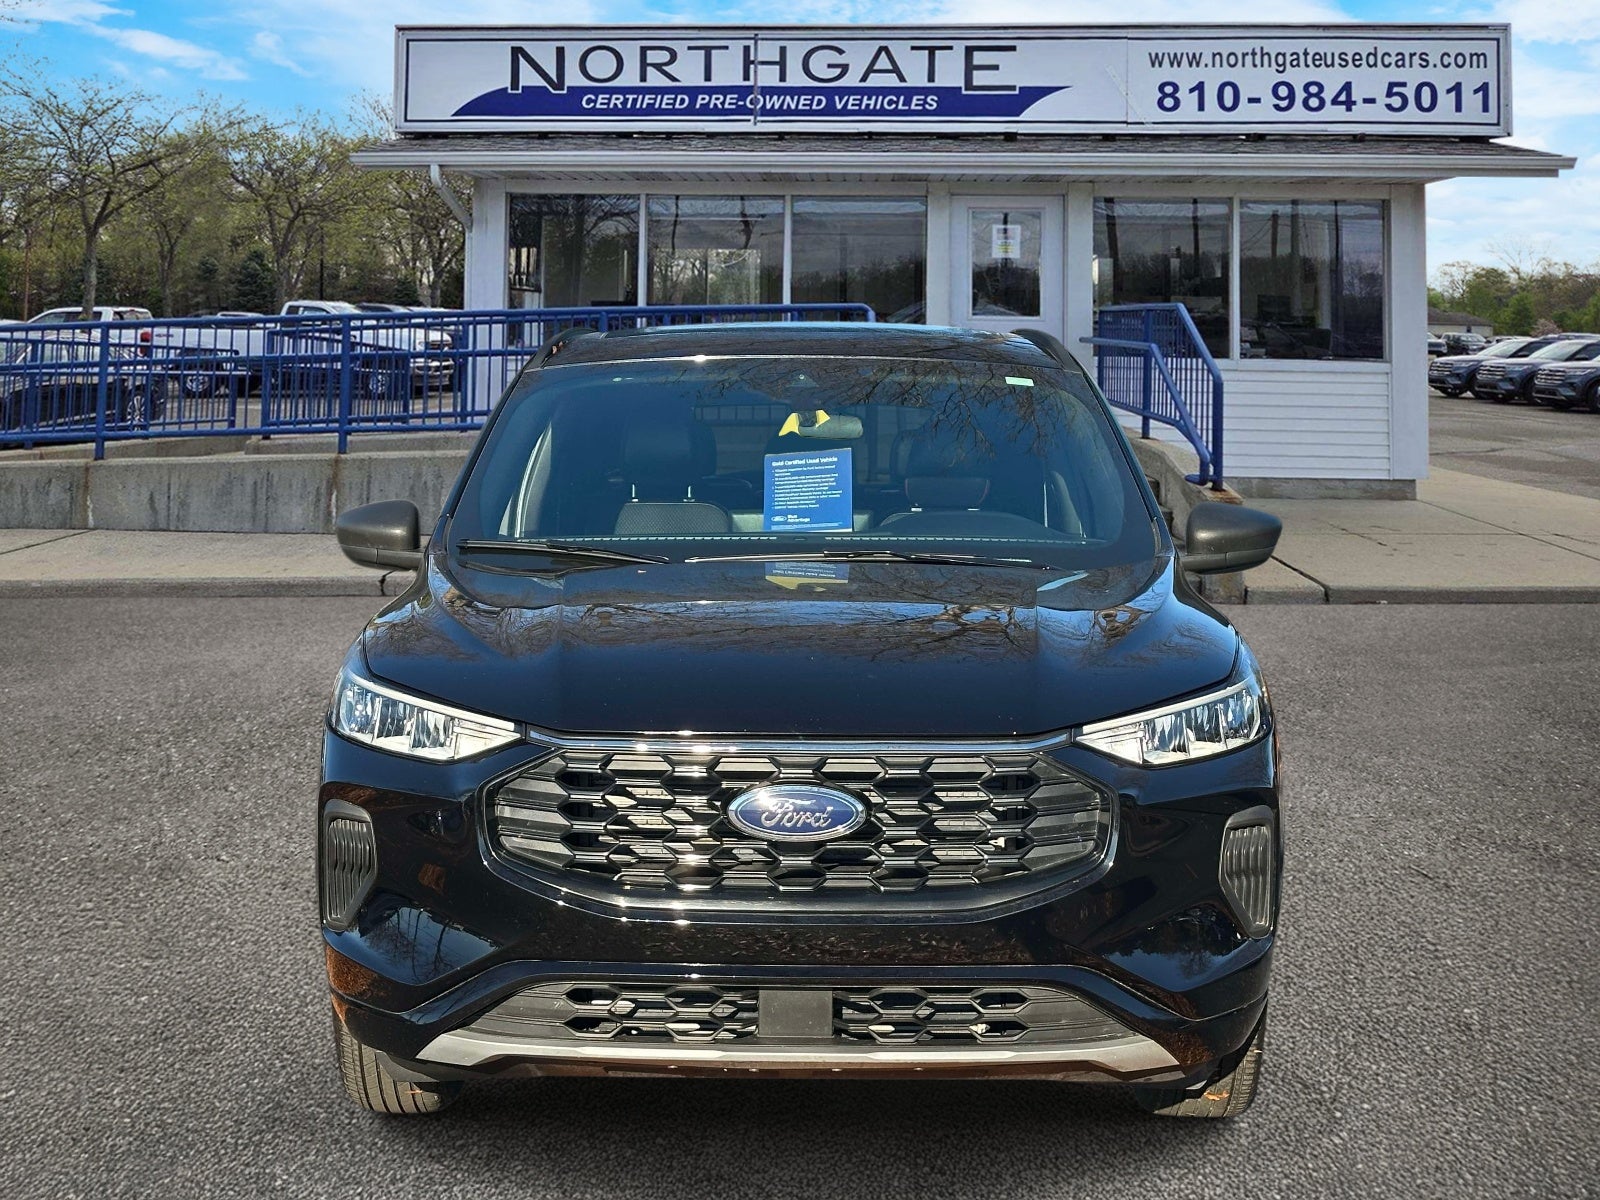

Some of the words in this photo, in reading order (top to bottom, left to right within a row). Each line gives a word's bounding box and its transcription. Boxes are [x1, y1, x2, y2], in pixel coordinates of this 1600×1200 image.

[510, 45, 1017, 92] NORTHGATE
[1148, 46, 1488, 74] www.northgateusedcars.com
[581, 94, 689, 110] CERTIFIED
[695, 94, 827, 111] PRE-OWNED
[834, 94, 938, 111] VEHICLES
[1156, 80, 1490, 113] 810-984-5011
[759, 799, 834, 828] Ford
